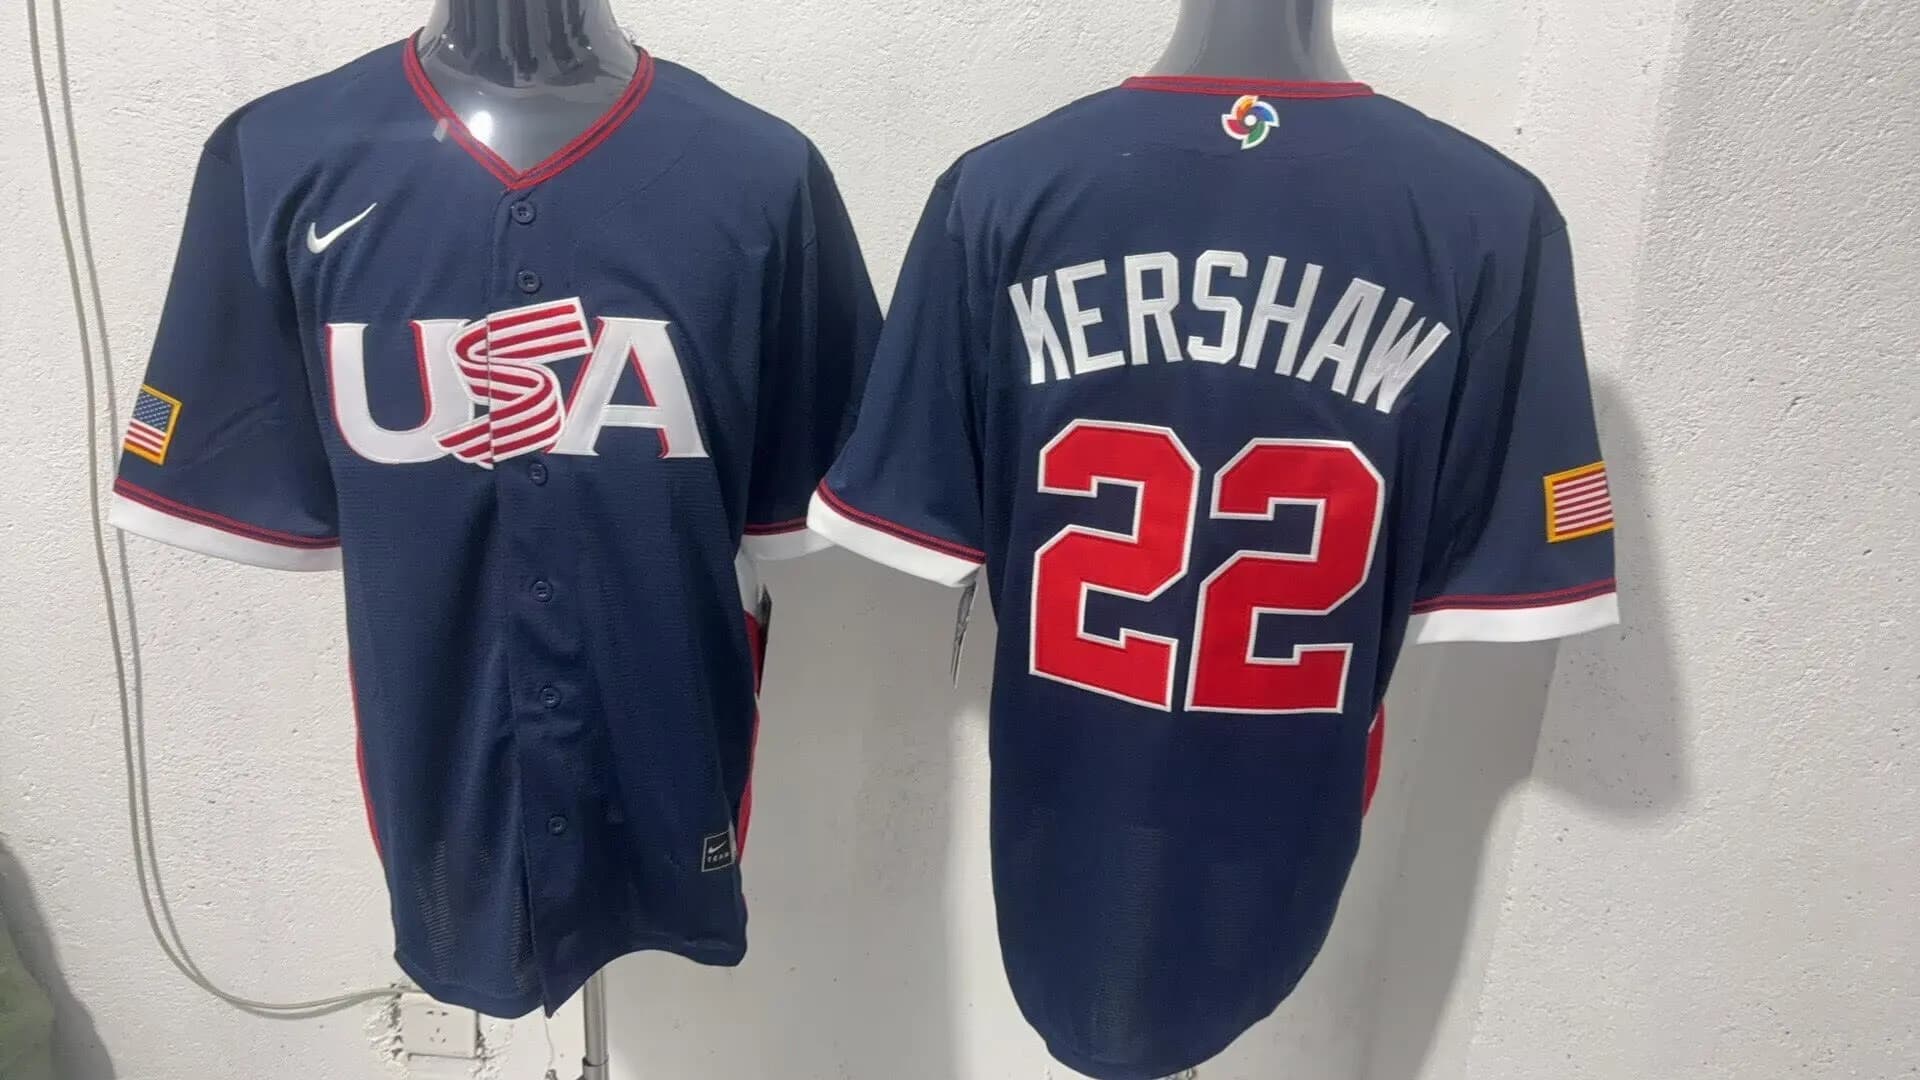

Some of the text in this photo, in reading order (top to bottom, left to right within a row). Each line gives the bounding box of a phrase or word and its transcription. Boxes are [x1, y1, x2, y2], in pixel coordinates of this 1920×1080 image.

[326, 297, 709, 470] USA
[1008, 250, 1451, 414] KERSHAW
[1029, 418, 1385, 713] 22
